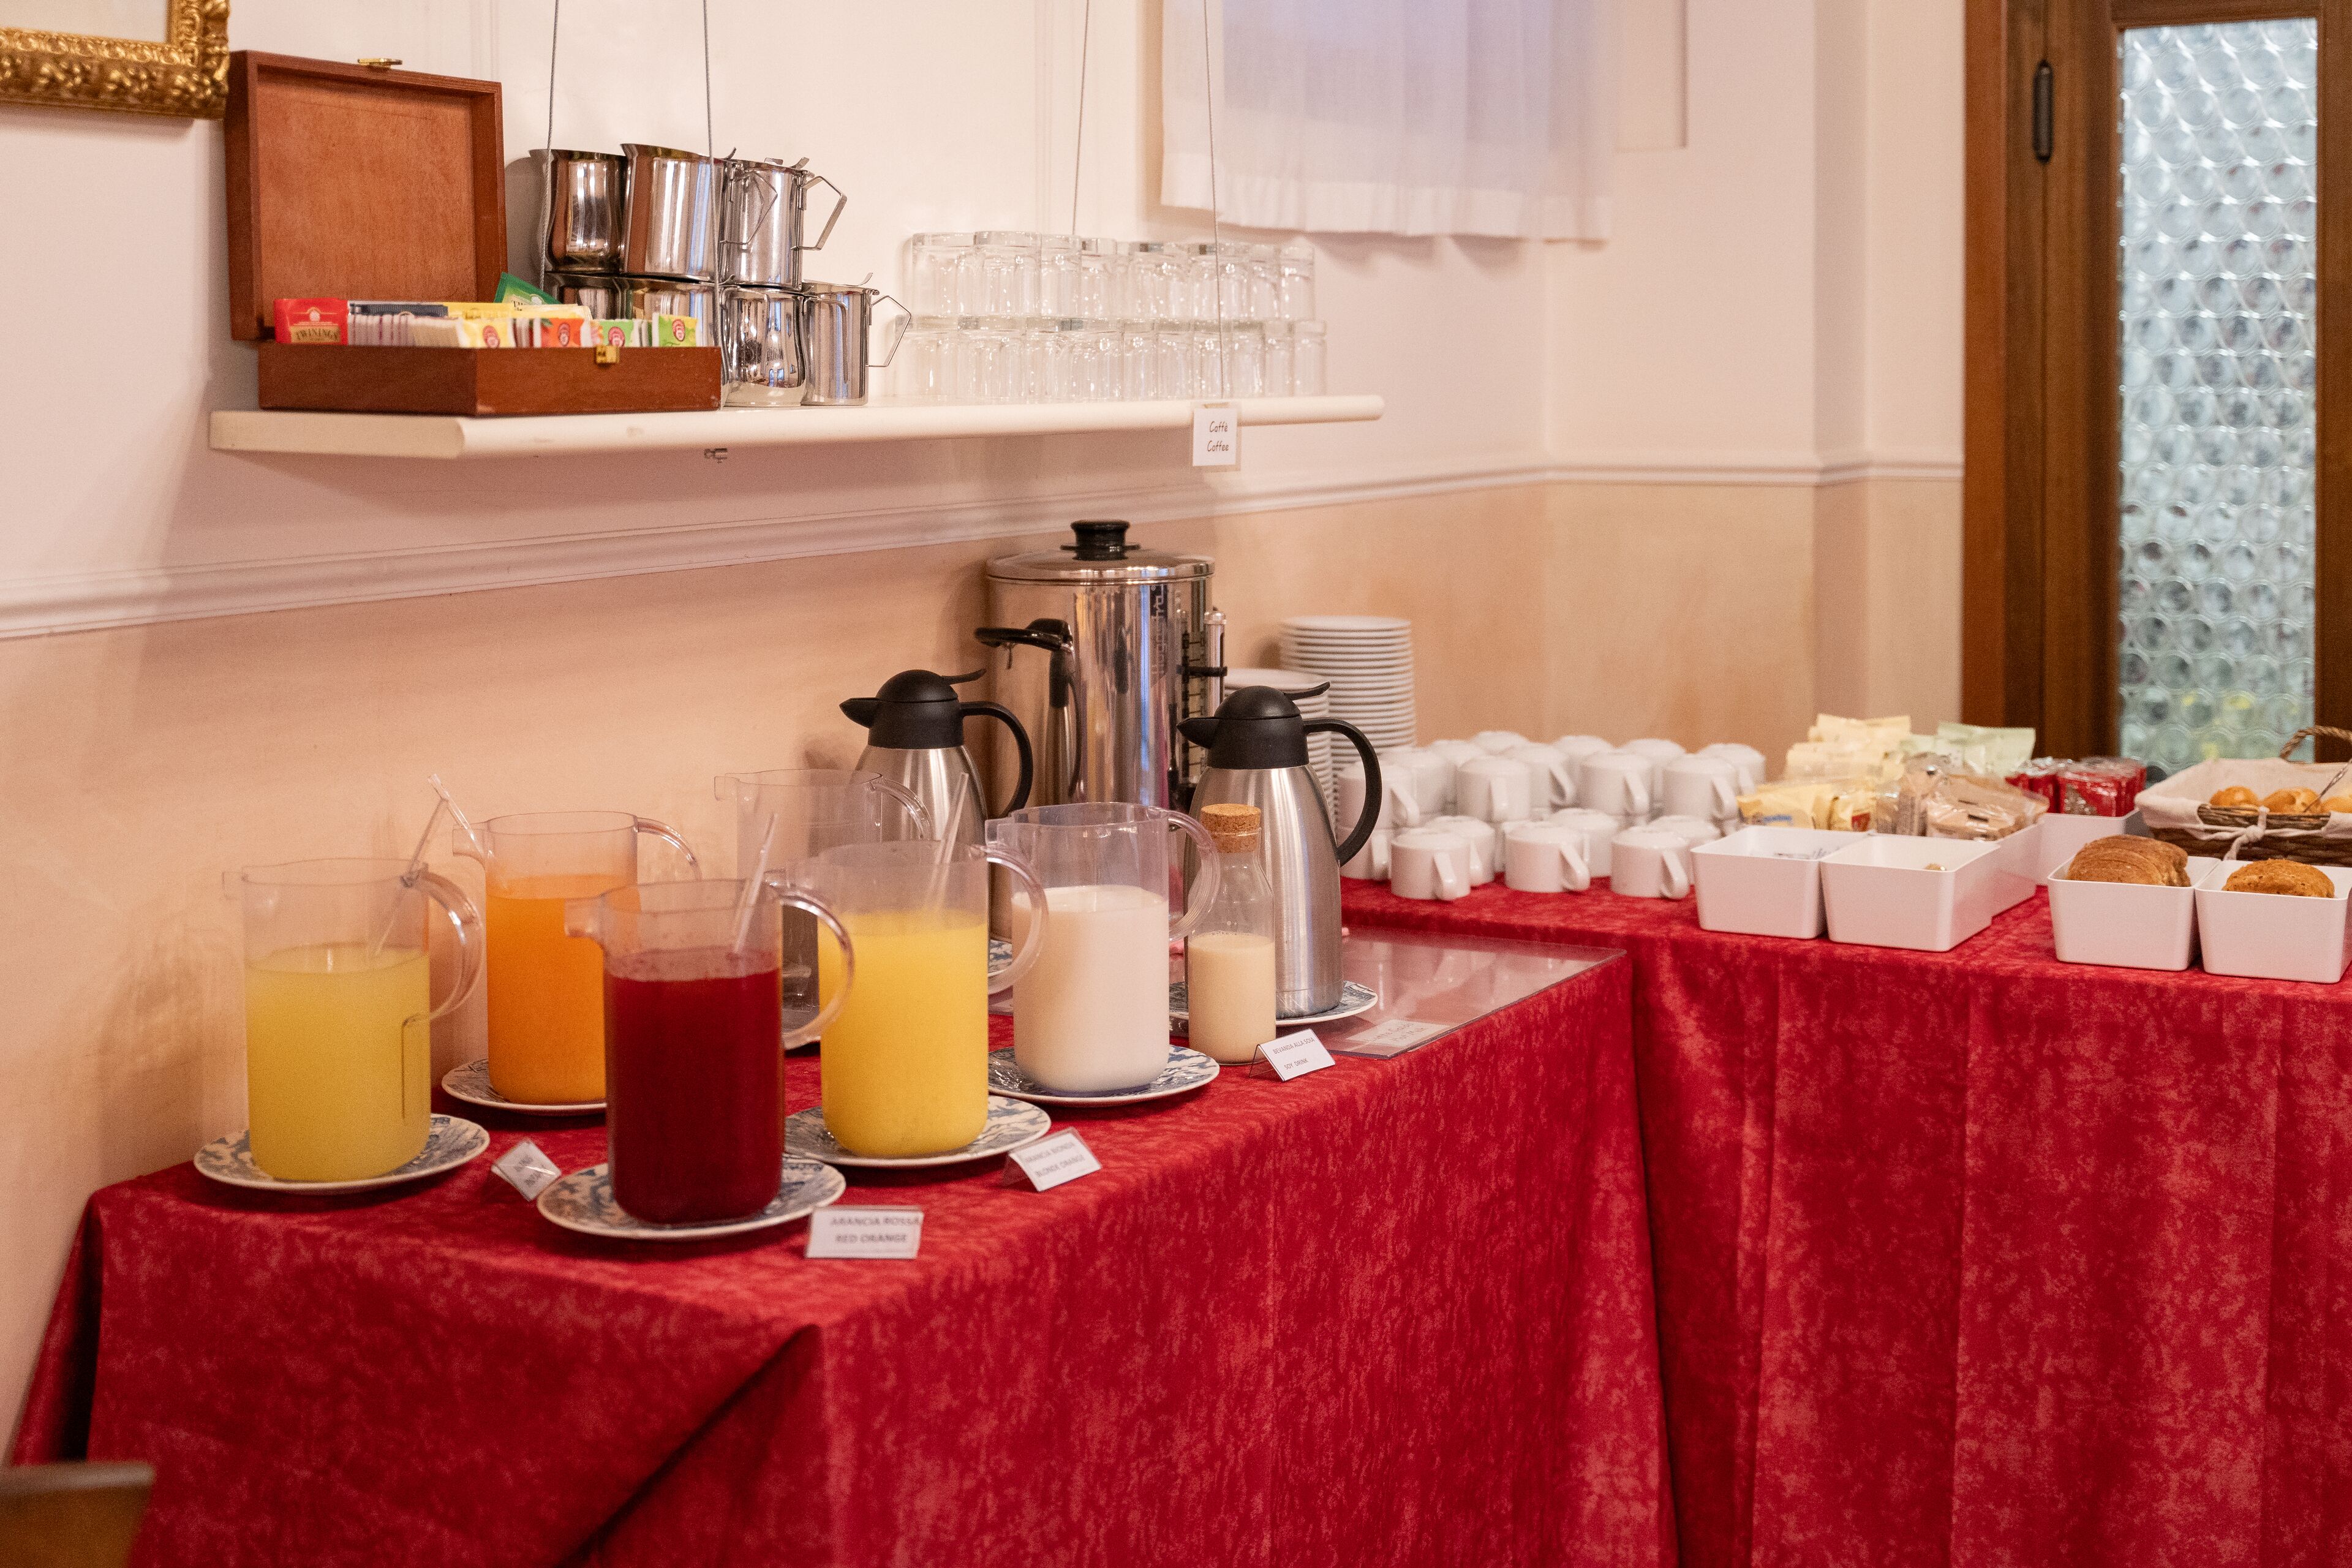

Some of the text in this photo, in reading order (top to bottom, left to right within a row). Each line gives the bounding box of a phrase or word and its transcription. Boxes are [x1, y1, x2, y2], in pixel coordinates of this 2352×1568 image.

[1207, 440, 1229, 452] Coffee
[1272, 1044, 1294, 1055] BEVANDA
[1294, 1040, 1305, 1049] ALLA
[1294, 1058, 1309, 1067] DRINK
[859, 1233, 907, 1243] ORANGE
